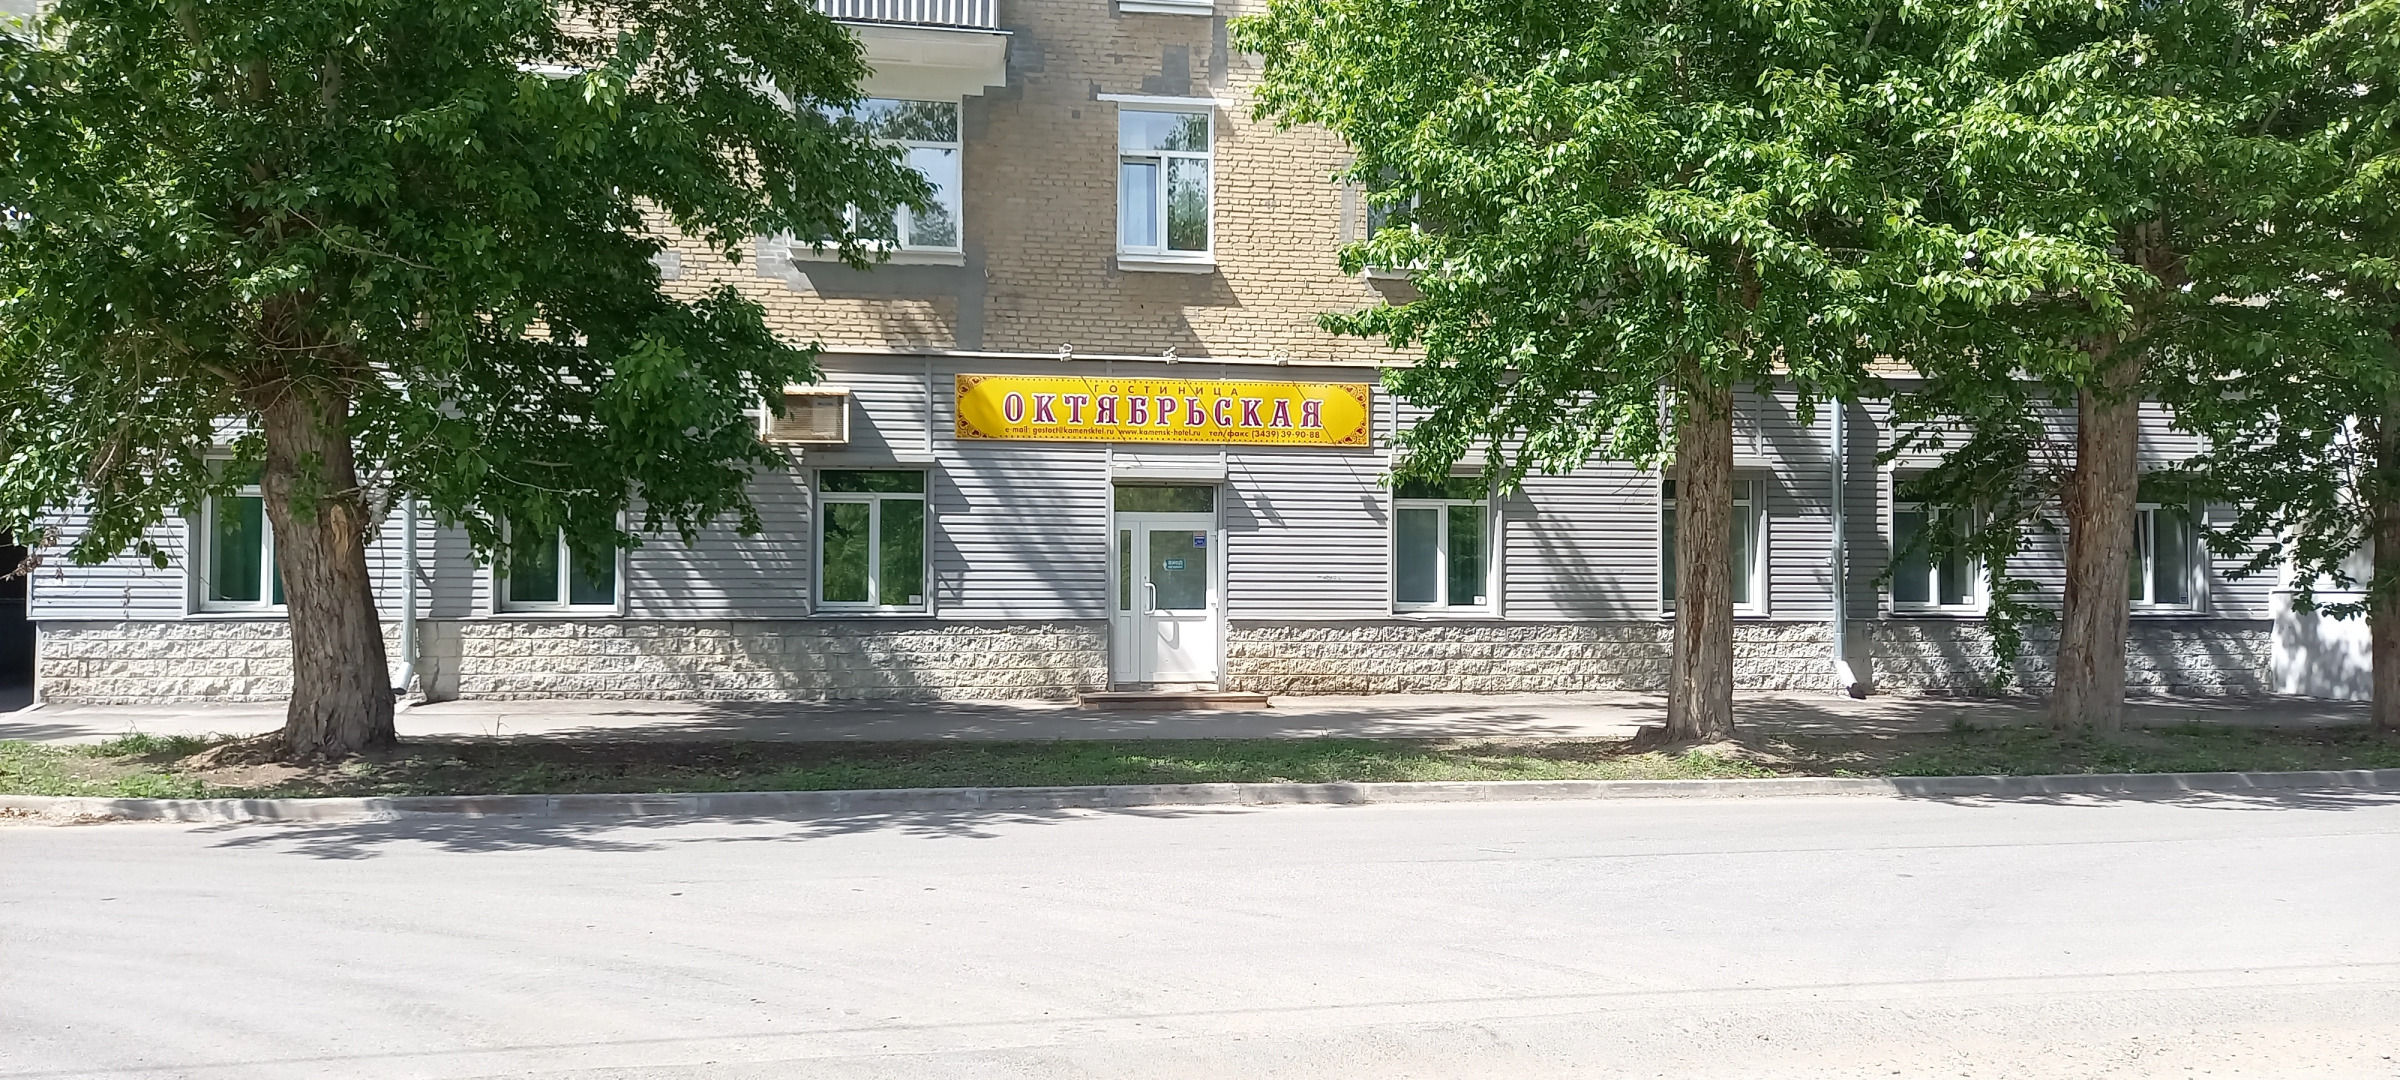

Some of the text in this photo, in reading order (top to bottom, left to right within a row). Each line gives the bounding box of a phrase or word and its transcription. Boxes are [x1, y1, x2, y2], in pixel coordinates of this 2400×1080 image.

[1094, 384, 1240, 397] ГОСТИНИЦА
[1003, 392, 1324, 429] ОКТЯБРЬСКАЯ
[1005, 425, 1030, 433] e-mail:
[1119, 428, 1201, 436] www.kamensk-hotel.ru
[1209, 429, 1249, 438] тел/факс
[1251, 430, 1279, 440] (3439)
[1281, 430, 1320, 439] 39-90-88
